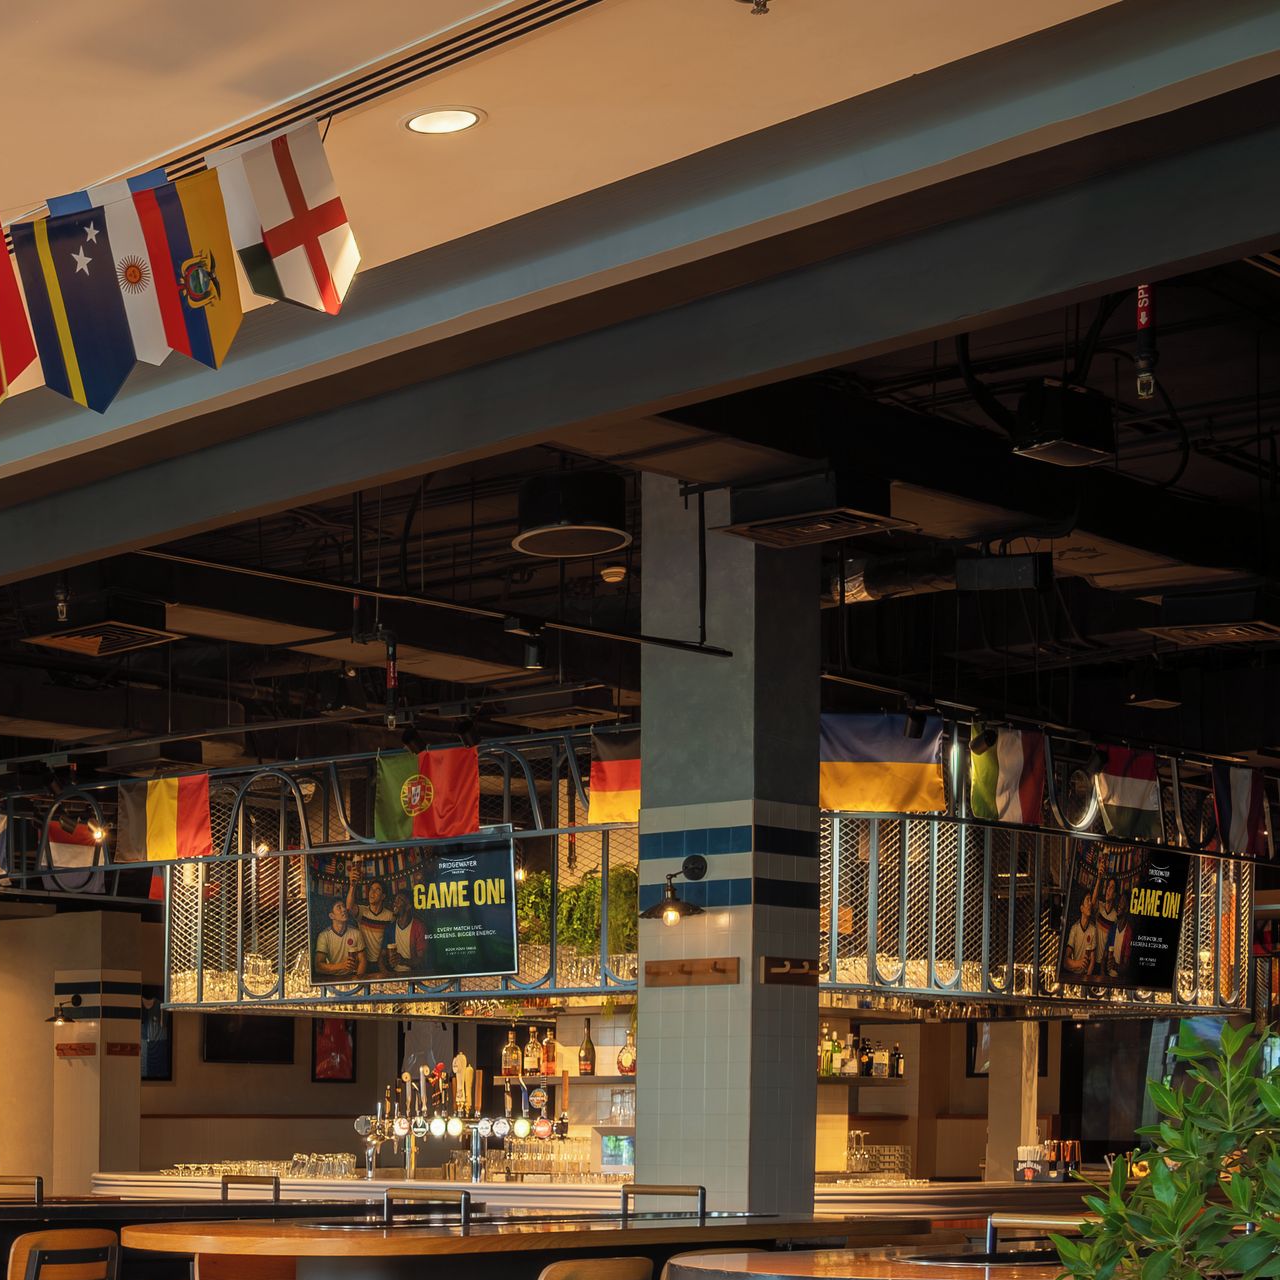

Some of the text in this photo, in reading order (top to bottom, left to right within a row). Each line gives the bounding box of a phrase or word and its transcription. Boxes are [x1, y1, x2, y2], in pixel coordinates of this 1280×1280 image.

[413, 878, 505, 910] GAME ON!
[1130, 887, 1181, 920] GAME ON!
